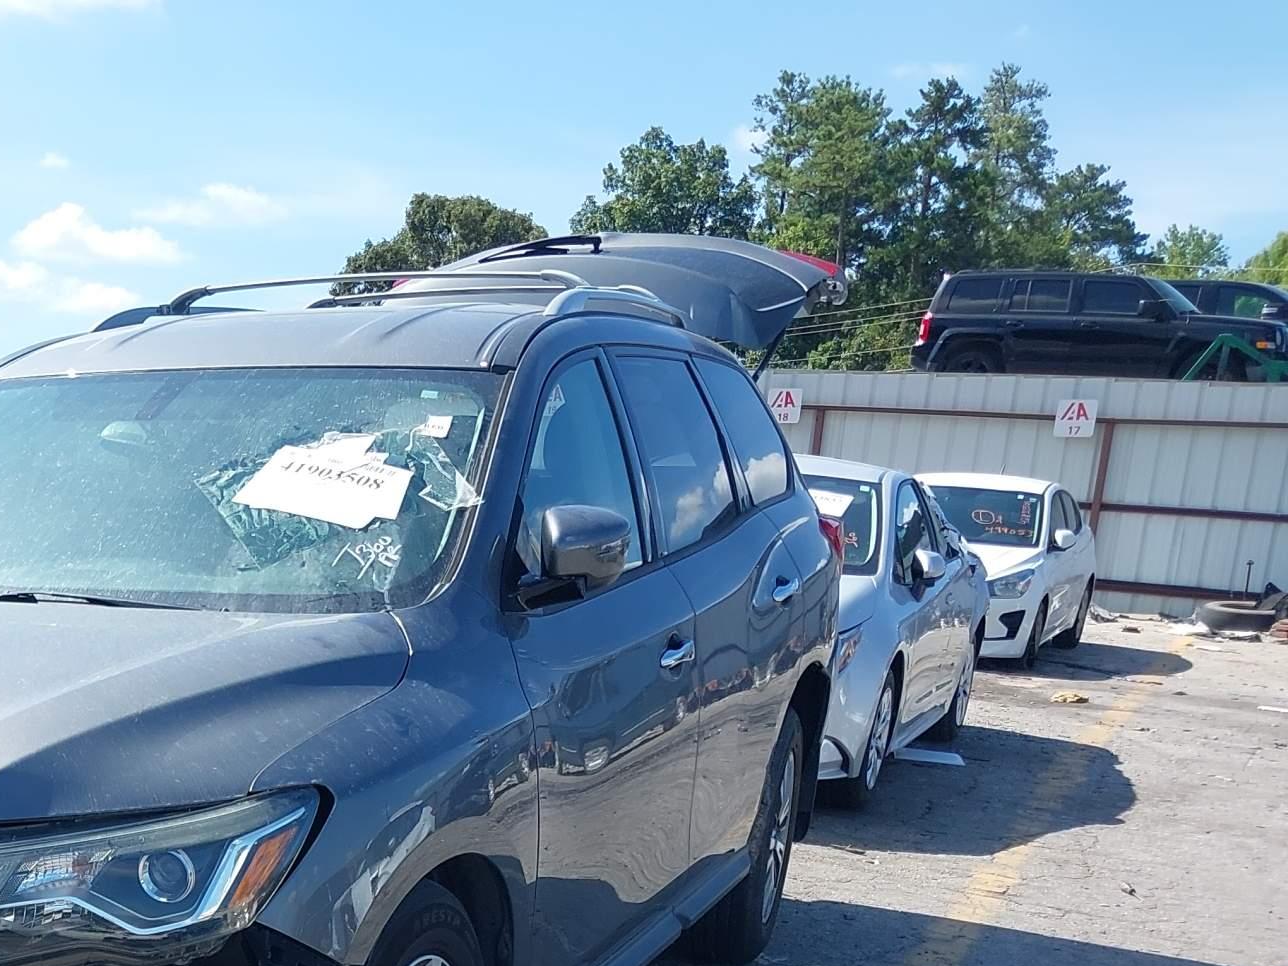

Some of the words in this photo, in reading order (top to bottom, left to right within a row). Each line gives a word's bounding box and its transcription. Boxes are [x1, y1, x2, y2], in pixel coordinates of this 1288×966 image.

[778, 413, 789, 421] 18
[1068, 426, 1081, 435] 17
[281, 461, 385, 489] 41903508
